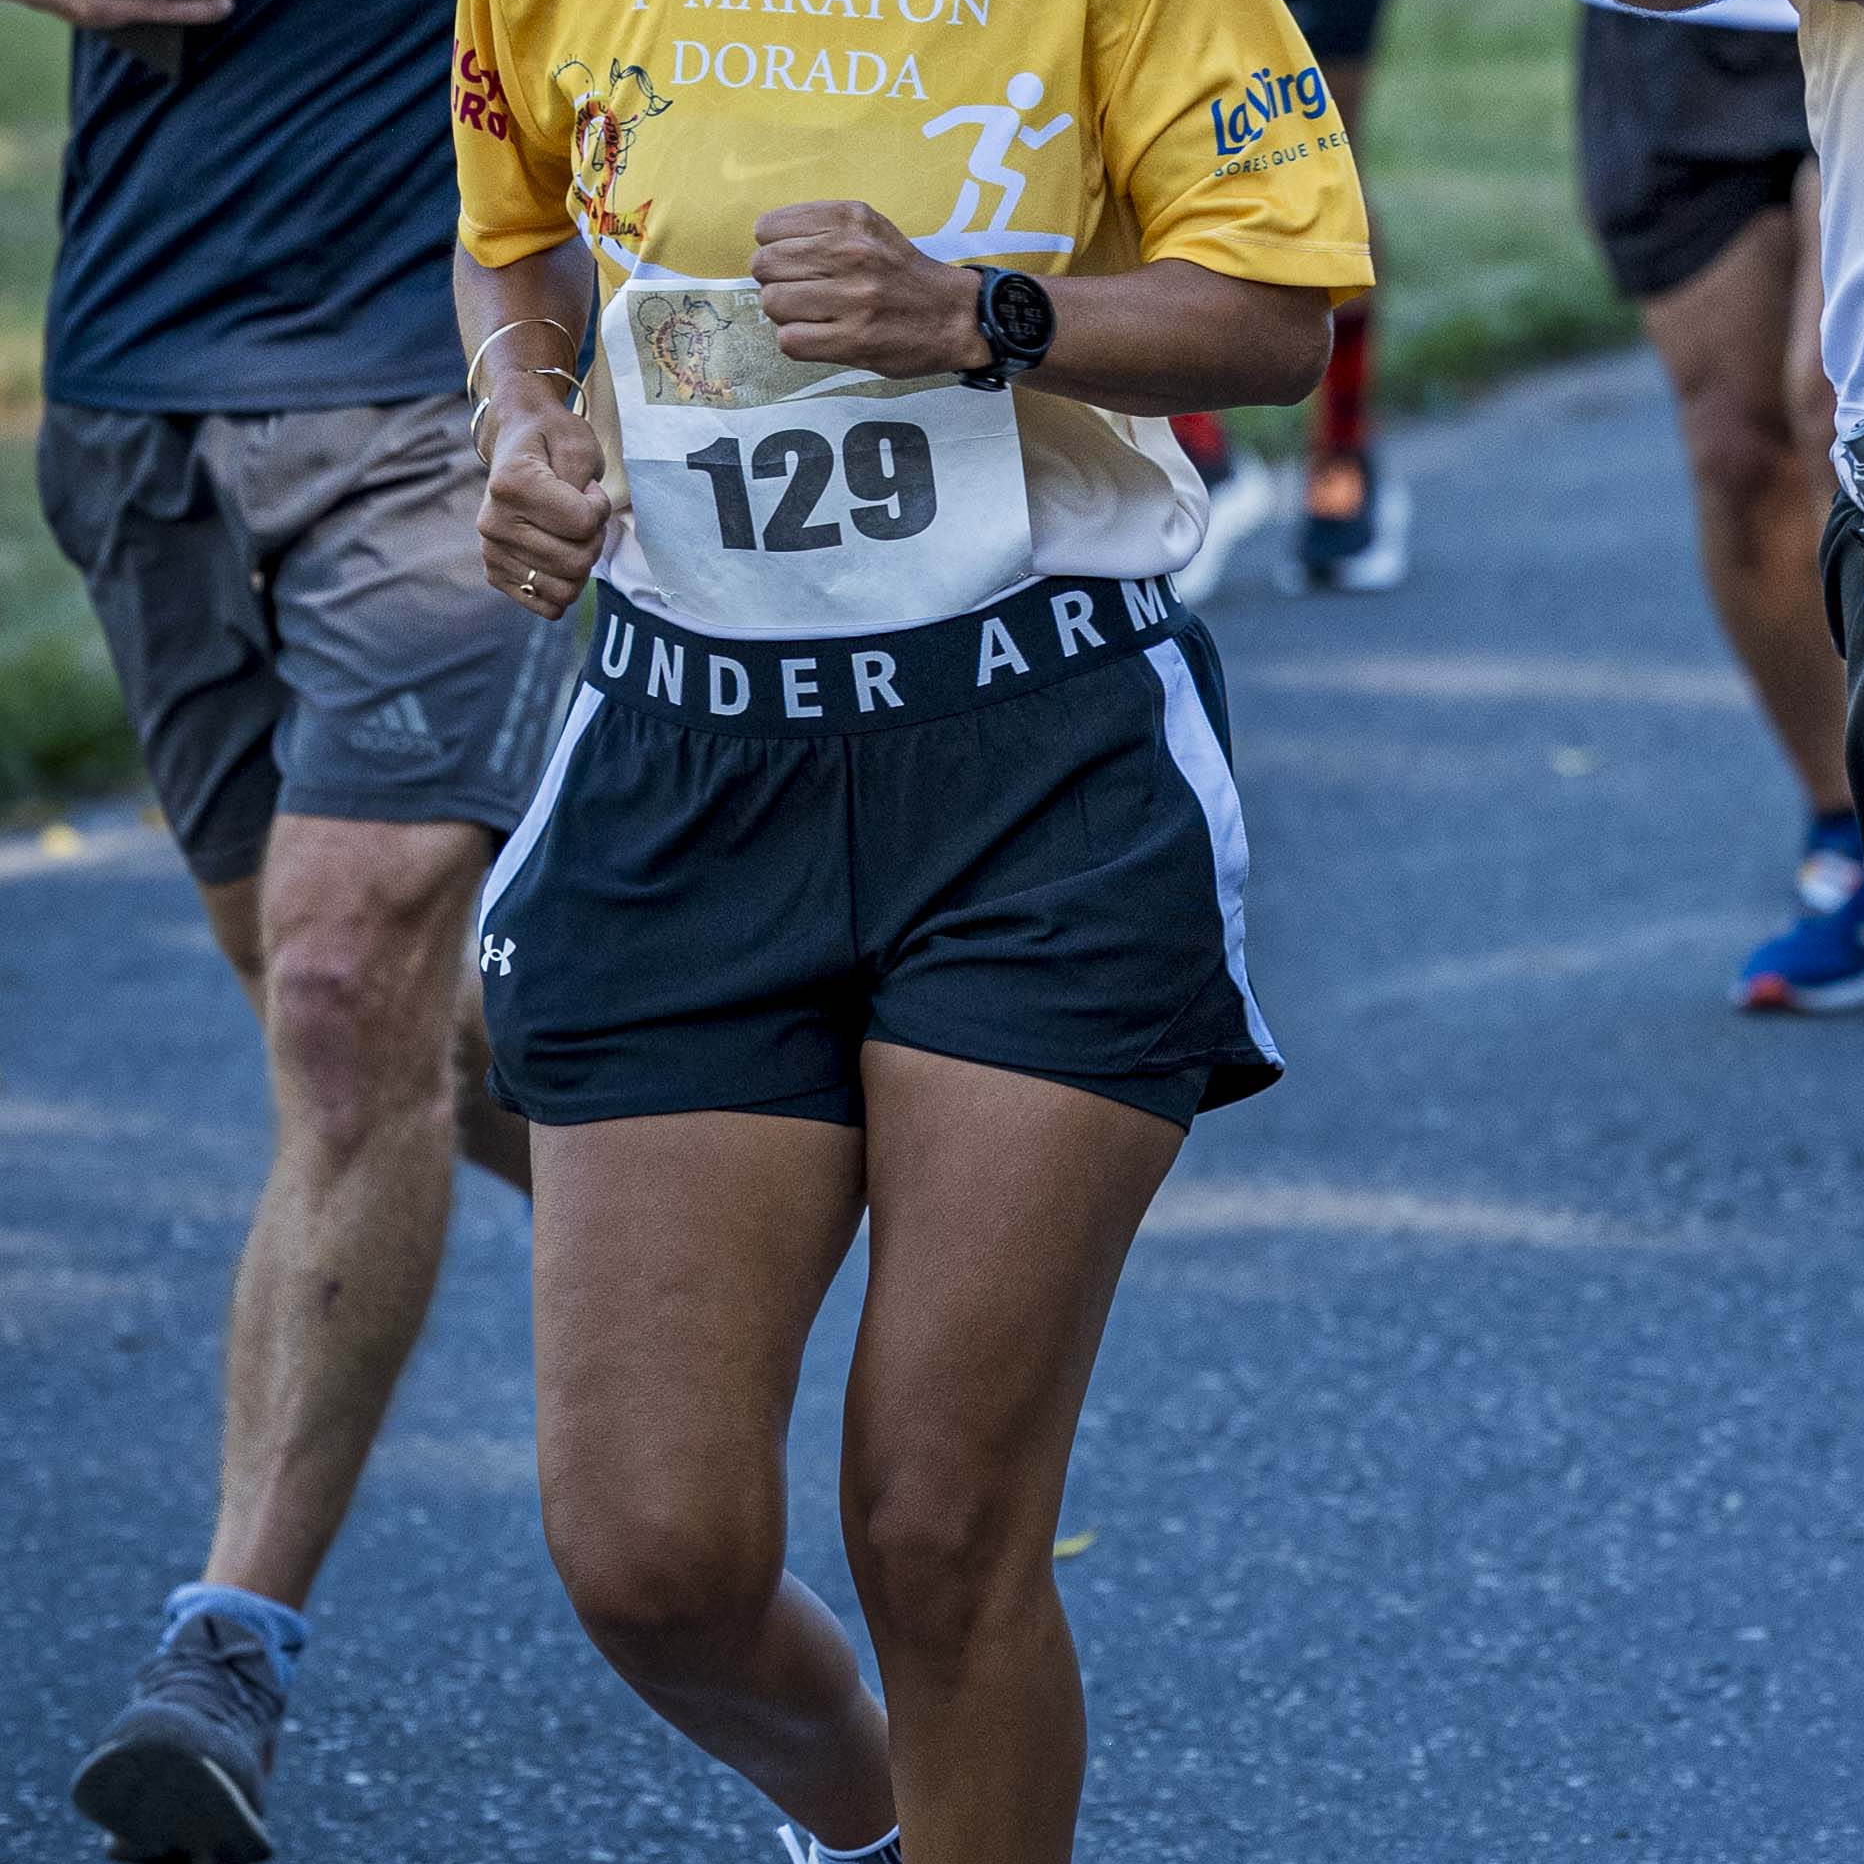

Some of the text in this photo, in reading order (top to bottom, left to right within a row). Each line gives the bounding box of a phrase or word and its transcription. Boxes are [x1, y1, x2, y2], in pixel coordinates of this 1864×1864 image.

[670, 40, 929, 99] DORADA
[1272, 143, 1309, 165] QUE
[685, 420, 941, 553] 129
[601, 613, 904, 719] UNDER
